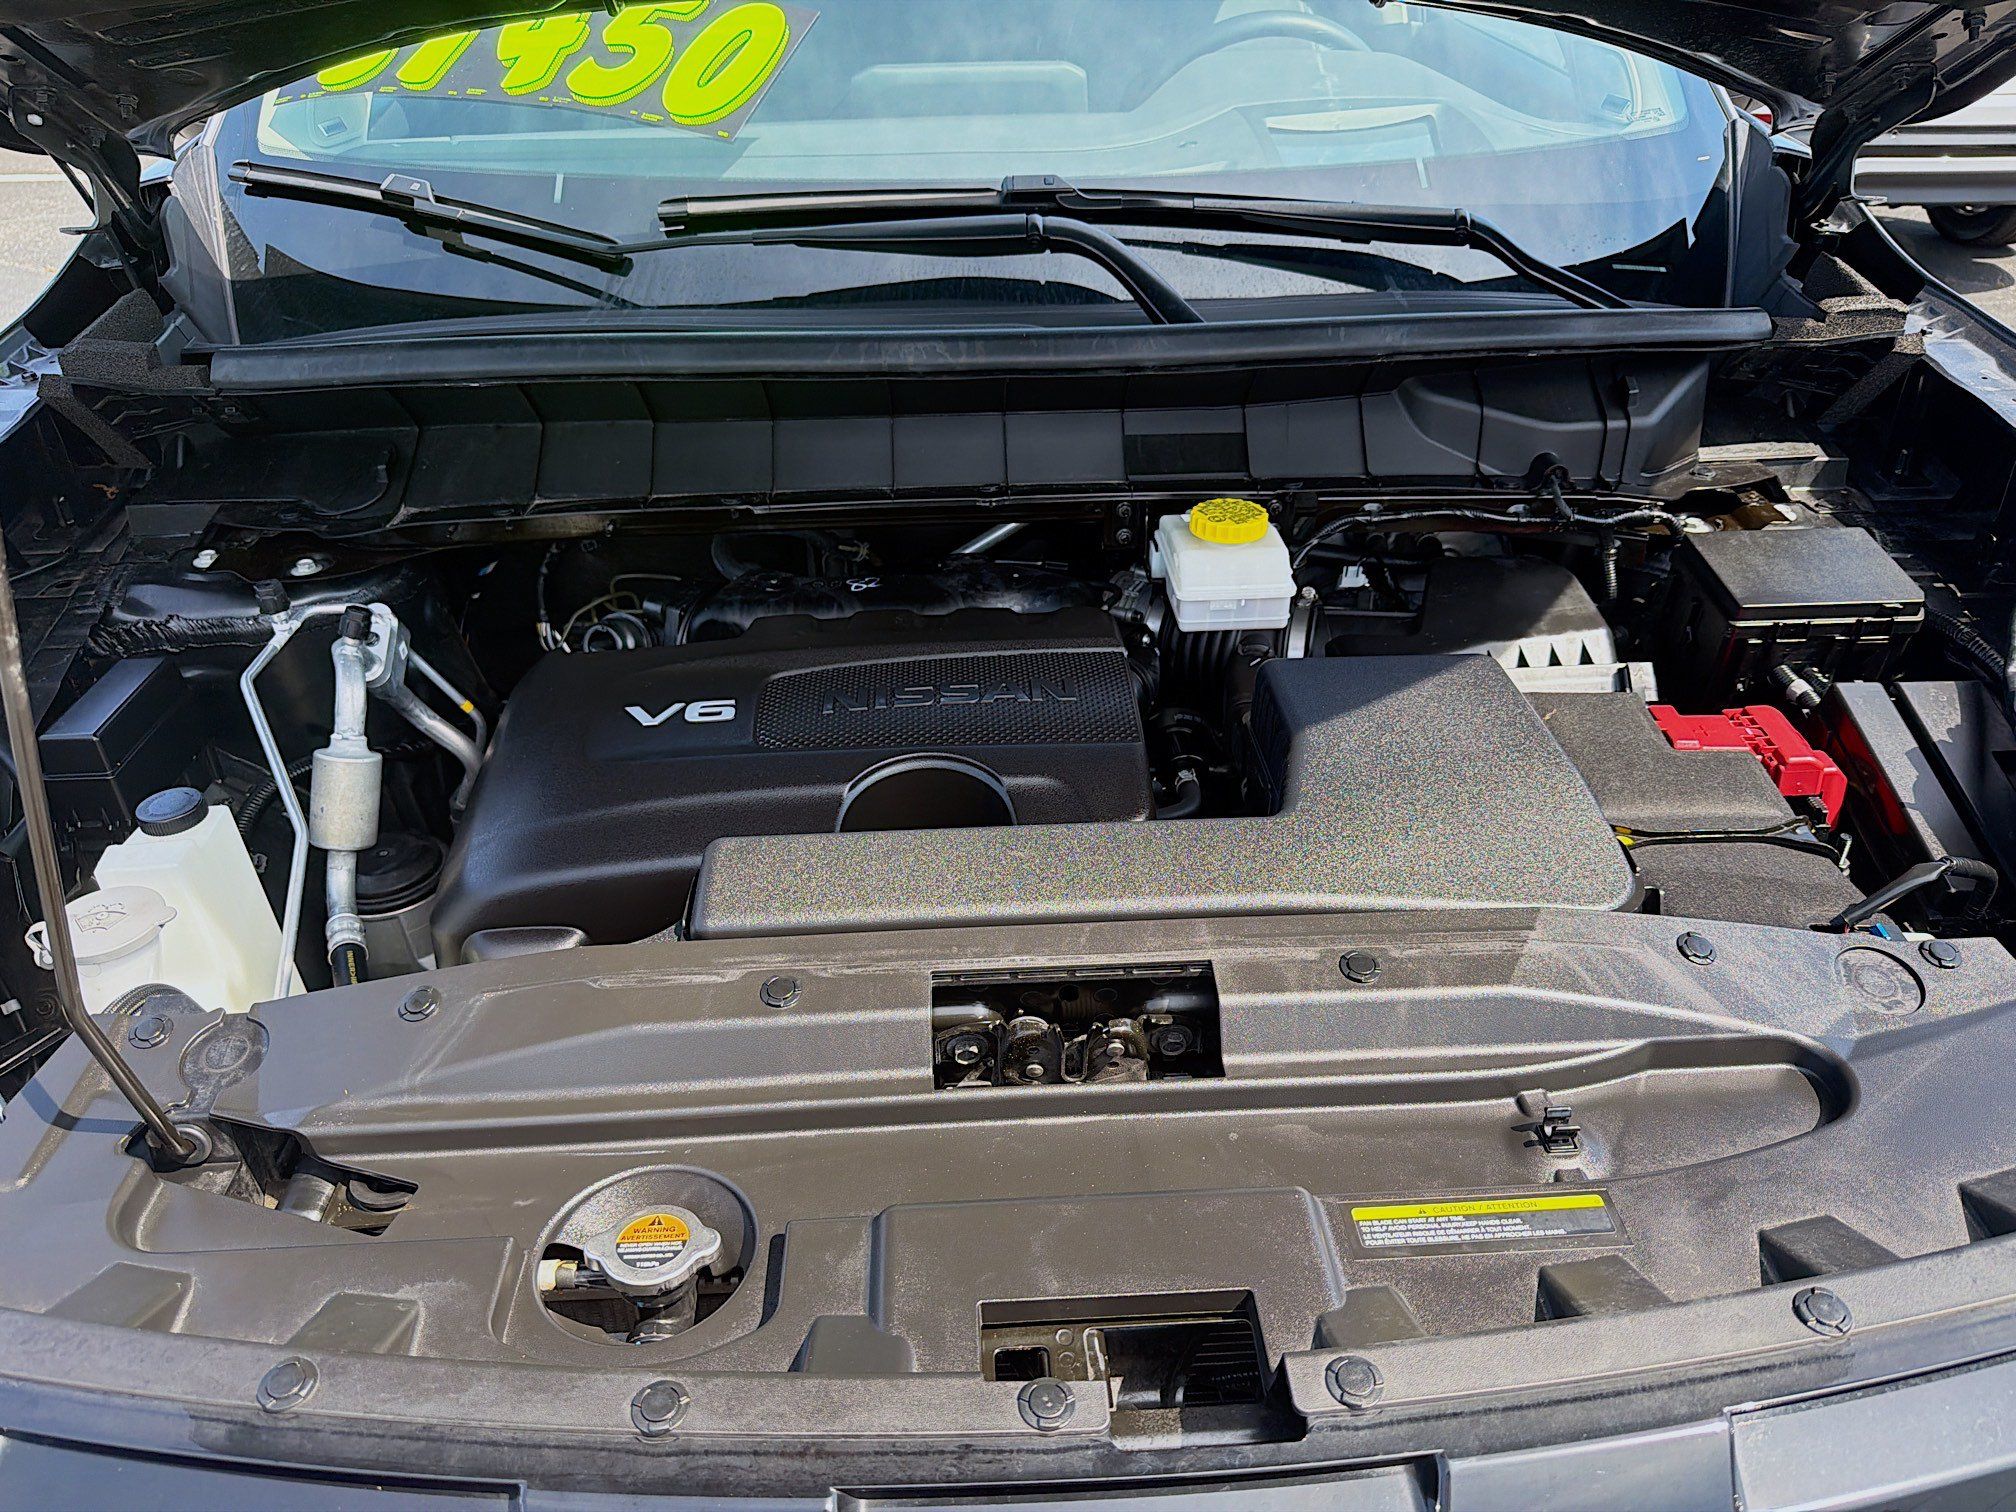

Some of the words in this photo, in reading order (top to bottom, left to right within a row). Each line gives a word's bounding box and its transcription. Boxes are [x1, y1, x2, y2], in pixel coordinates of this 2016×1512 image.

[822, 678, 1077, 715] NISSAN
[624, 698, 736, 728] V6
[1433, 1204, 1476, 1214] CAUTION
[1486, 1202, 1538, 1210] ATTENTION
[620, 1232, 686, 1240] AVERTISSEMENT
